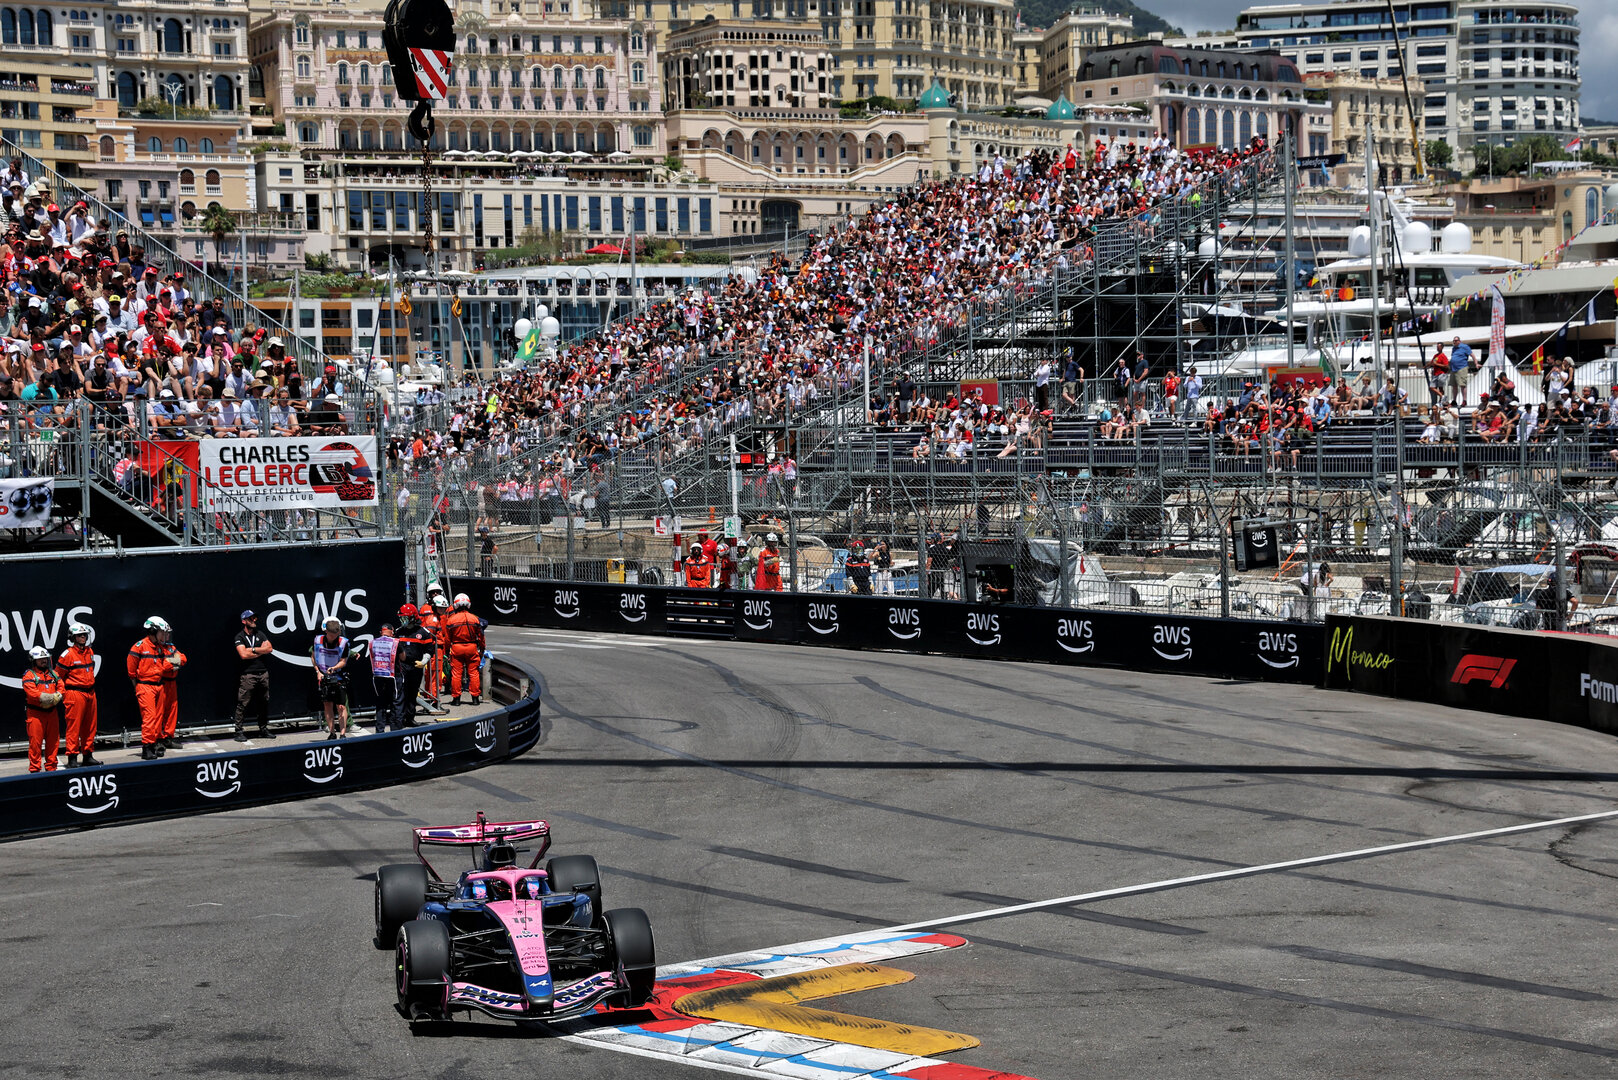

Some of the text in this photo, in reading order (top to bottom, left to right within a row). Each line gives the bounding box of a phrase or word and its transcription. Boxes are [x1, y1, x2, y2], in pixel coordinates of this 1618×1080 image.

[219, 445, 310, 464] CHARLES
[205, 464, 308, 488] LECLERC
[215, 493, 314, 504] MARCHE FAN CLUB
[254, 487, 302, 495] OFFICIAL
[1252, 531, 1267, 541] aws
[495, 587, 517, 601] aws
[555, 590, 579, 605] aws
[621, 594, 646, 609] aws
[266, 589, 369, 634] aws
[744, 600, 771, 616] aws
[809, 603, 838, 620] aws
[889, 608, 920, 625] aws
[968, 613, 1000, 631] aws
[1058, 619, 1093, 638] aws
[1154, 626, 1191, 645] aws
[1259, 632, 1298, 652] aws
[1328, 625, 1395, 681] Monaco
[1581, 673, 1618, 703] Form
[475, 719, 496, 739] aws
[403, 733, 433, 754] aws
[305, 747, 342, 768] aws
[197, 760, 240, 782] aws
[69, 774, 117, 798] aws
